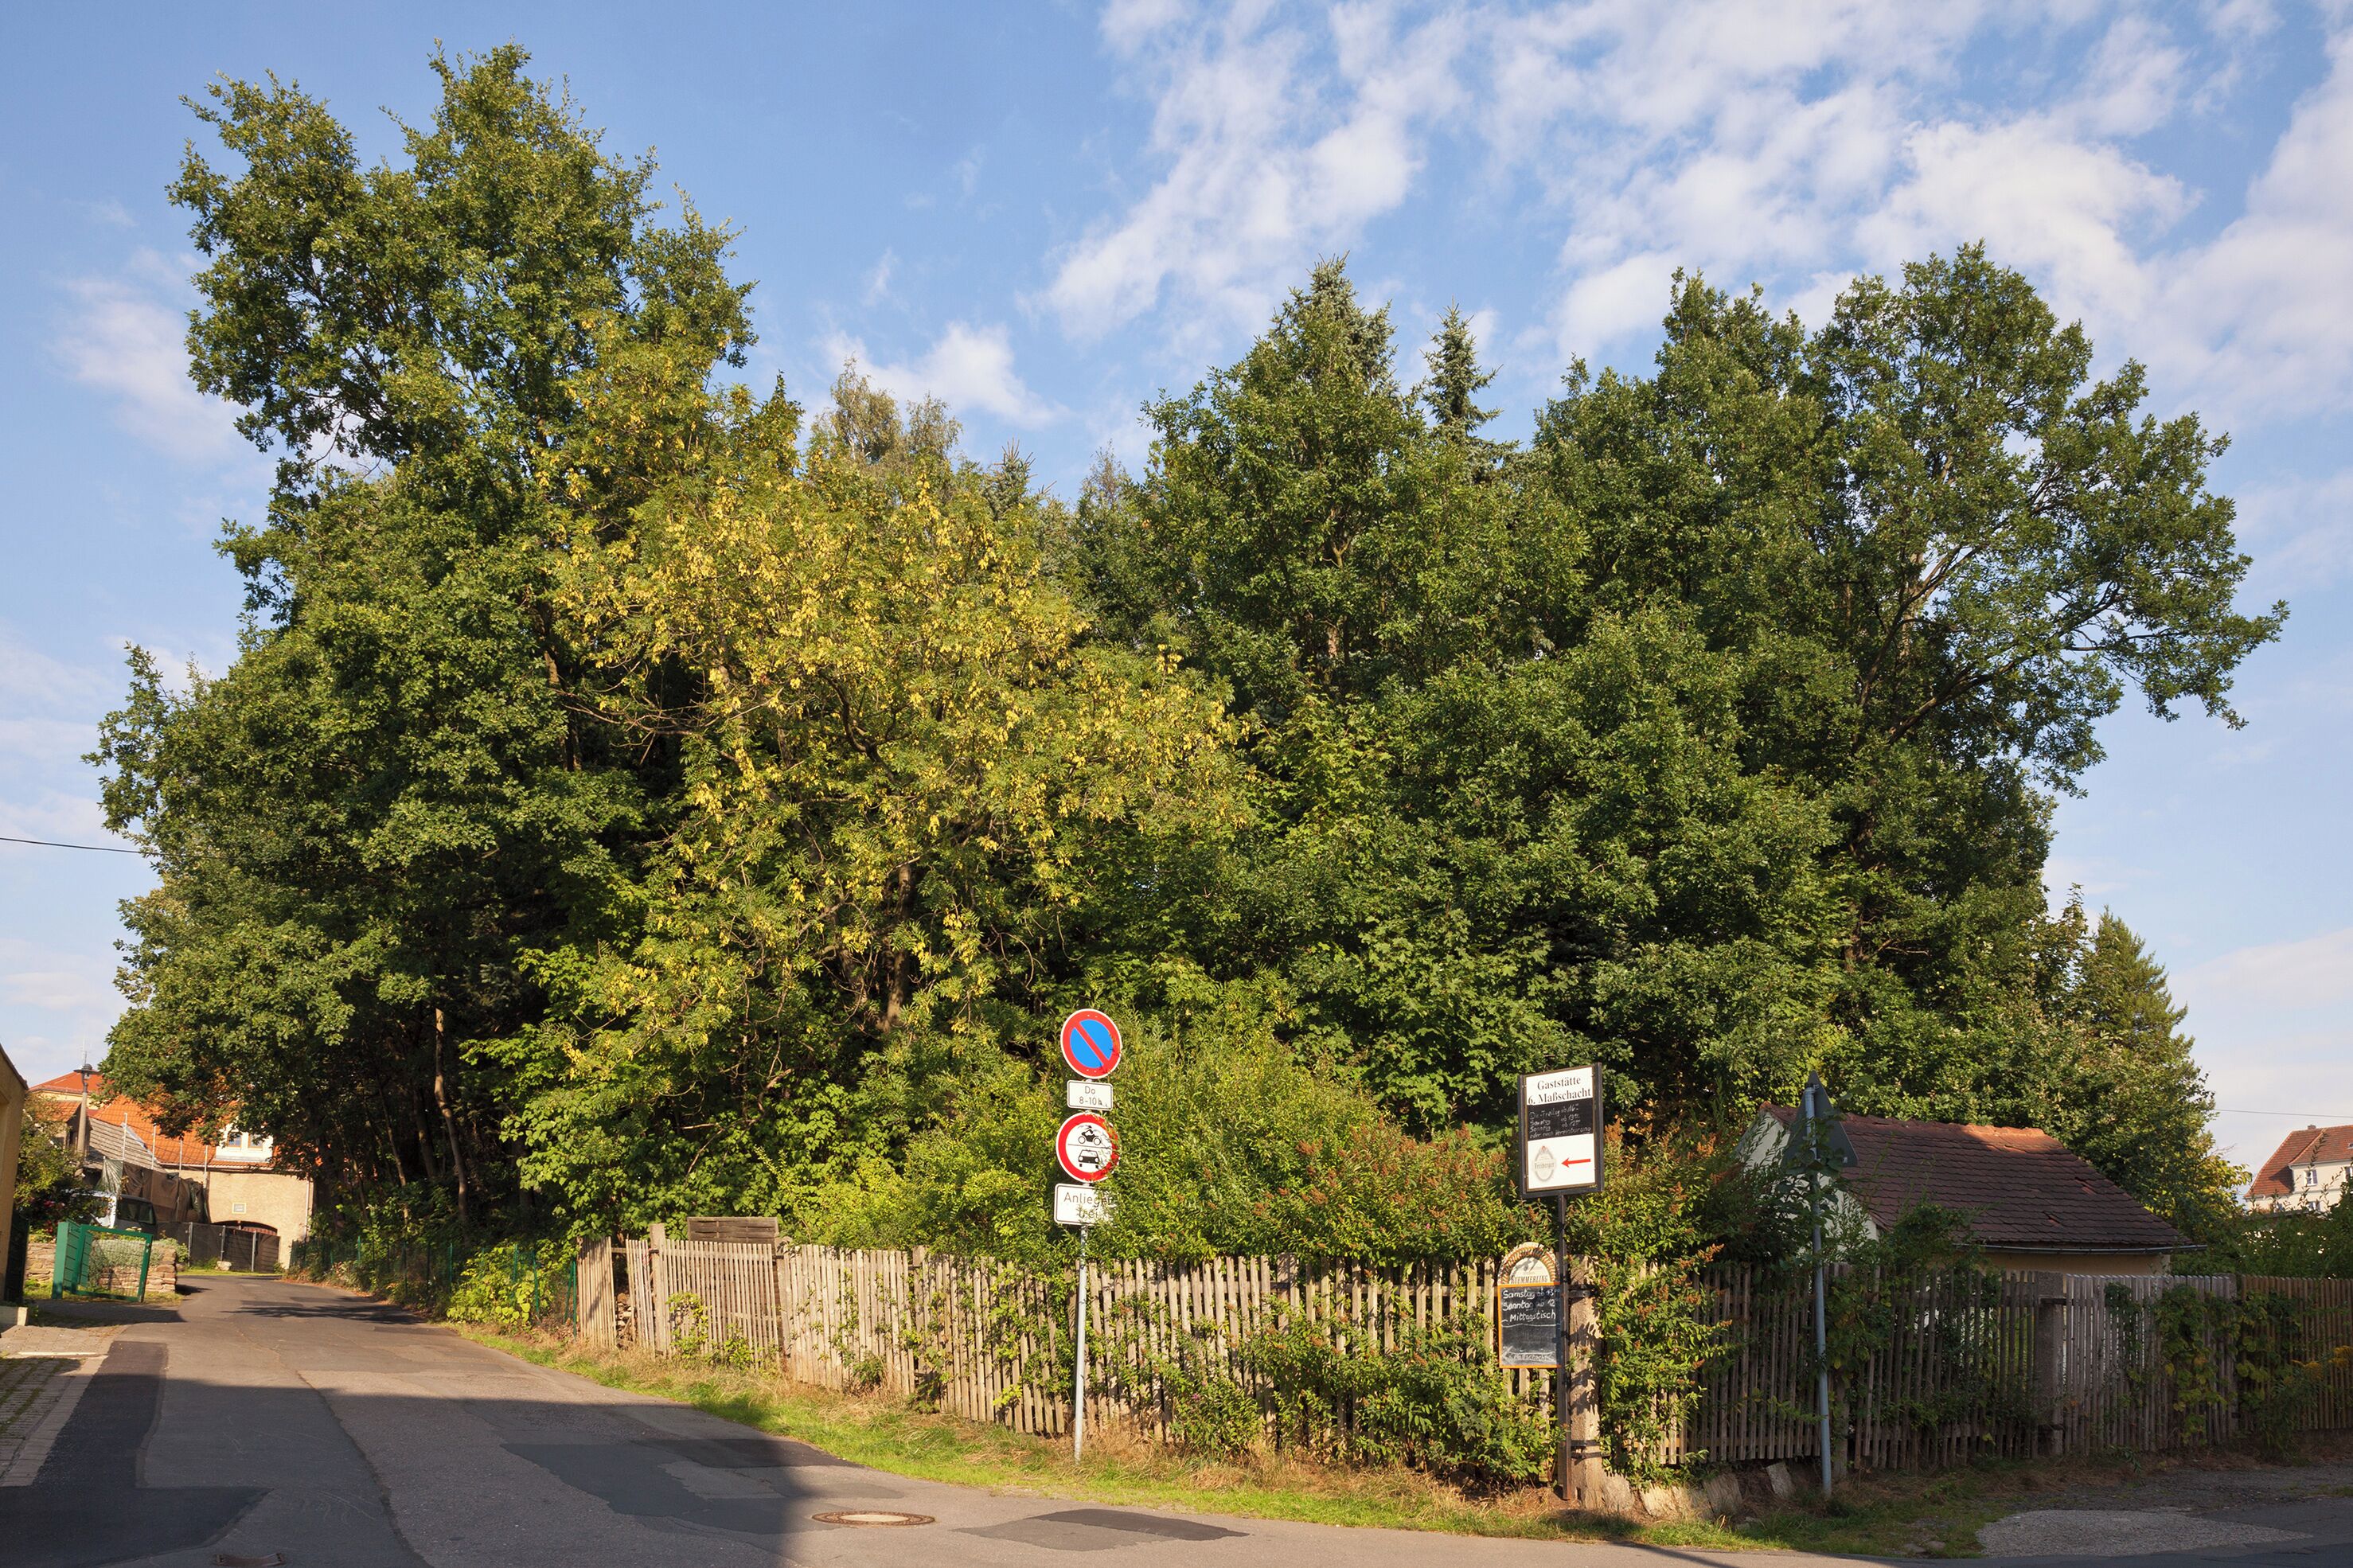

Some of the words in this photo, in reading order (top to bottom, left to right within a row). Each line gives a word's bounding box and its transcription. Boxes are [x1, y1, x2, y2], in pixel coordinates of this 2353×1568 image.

[1084, 1086, 1096, 1094] Do
[1537, 1076, 1582, 1090] Gaststätte
[1079, 1096, 1097, 1106] 8-10
[1528, 1095, 1535, 1105] 6.
[1538, 1087, 1591, 1104] Maßschacht
[1502, 1287, 1535, 1300] Samstag
[1537, 1285, 1544, 1297] ab
[1502, 1299, 1534, 1312] Sonntag
[1510, 1308, 1556, 1323] Mittagstisch
